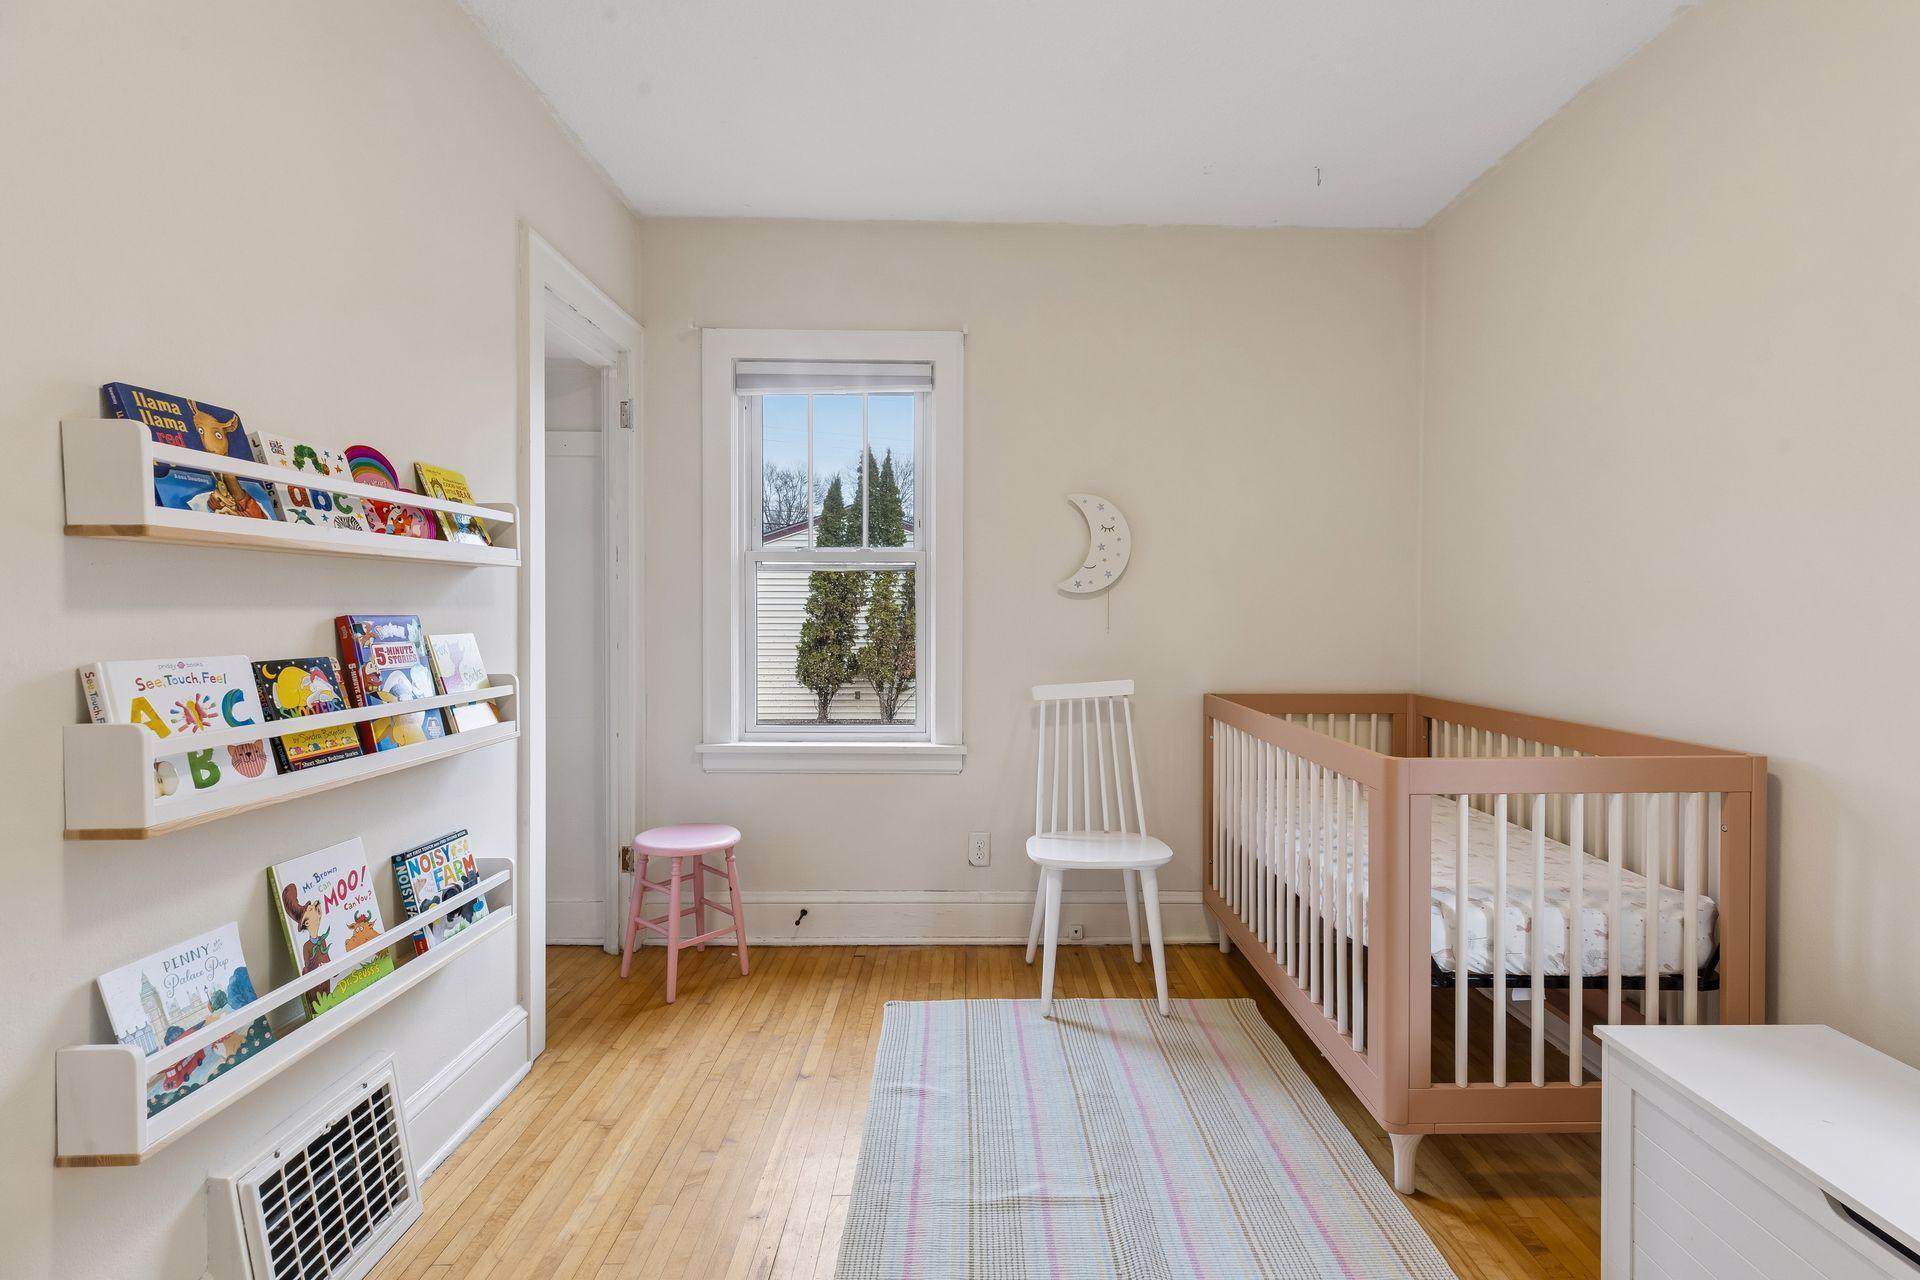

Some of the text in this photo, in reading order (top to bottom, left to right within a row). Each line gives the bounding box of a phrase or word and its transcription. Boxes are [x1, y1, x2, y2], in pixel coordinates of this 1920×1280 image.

[131, 391, 182, 416] llama
[138, 408, 188, 433] llama
[156, 432, 187, 448] red
[374, 645, 414, 666] 5-MINUTE
[388, 653, 418, 665] STORIES
[201, 671, 227, 684] Feel
[131, 696, 171, 739] A
[221, 688, 255, 727] C
[187, 748, 221, 789] B
[408, 845, 451, 878] NOISY
[433, 854, 477, 892] FARM
[302, 866, 338, 893] Mr. Brown
[323, 865, 366, 915] MOO!
[396, 864, 416, 905] NOISY
[162, 943, 211, 973] PENNY
[164, 955, 229, 998] Palace Pup
